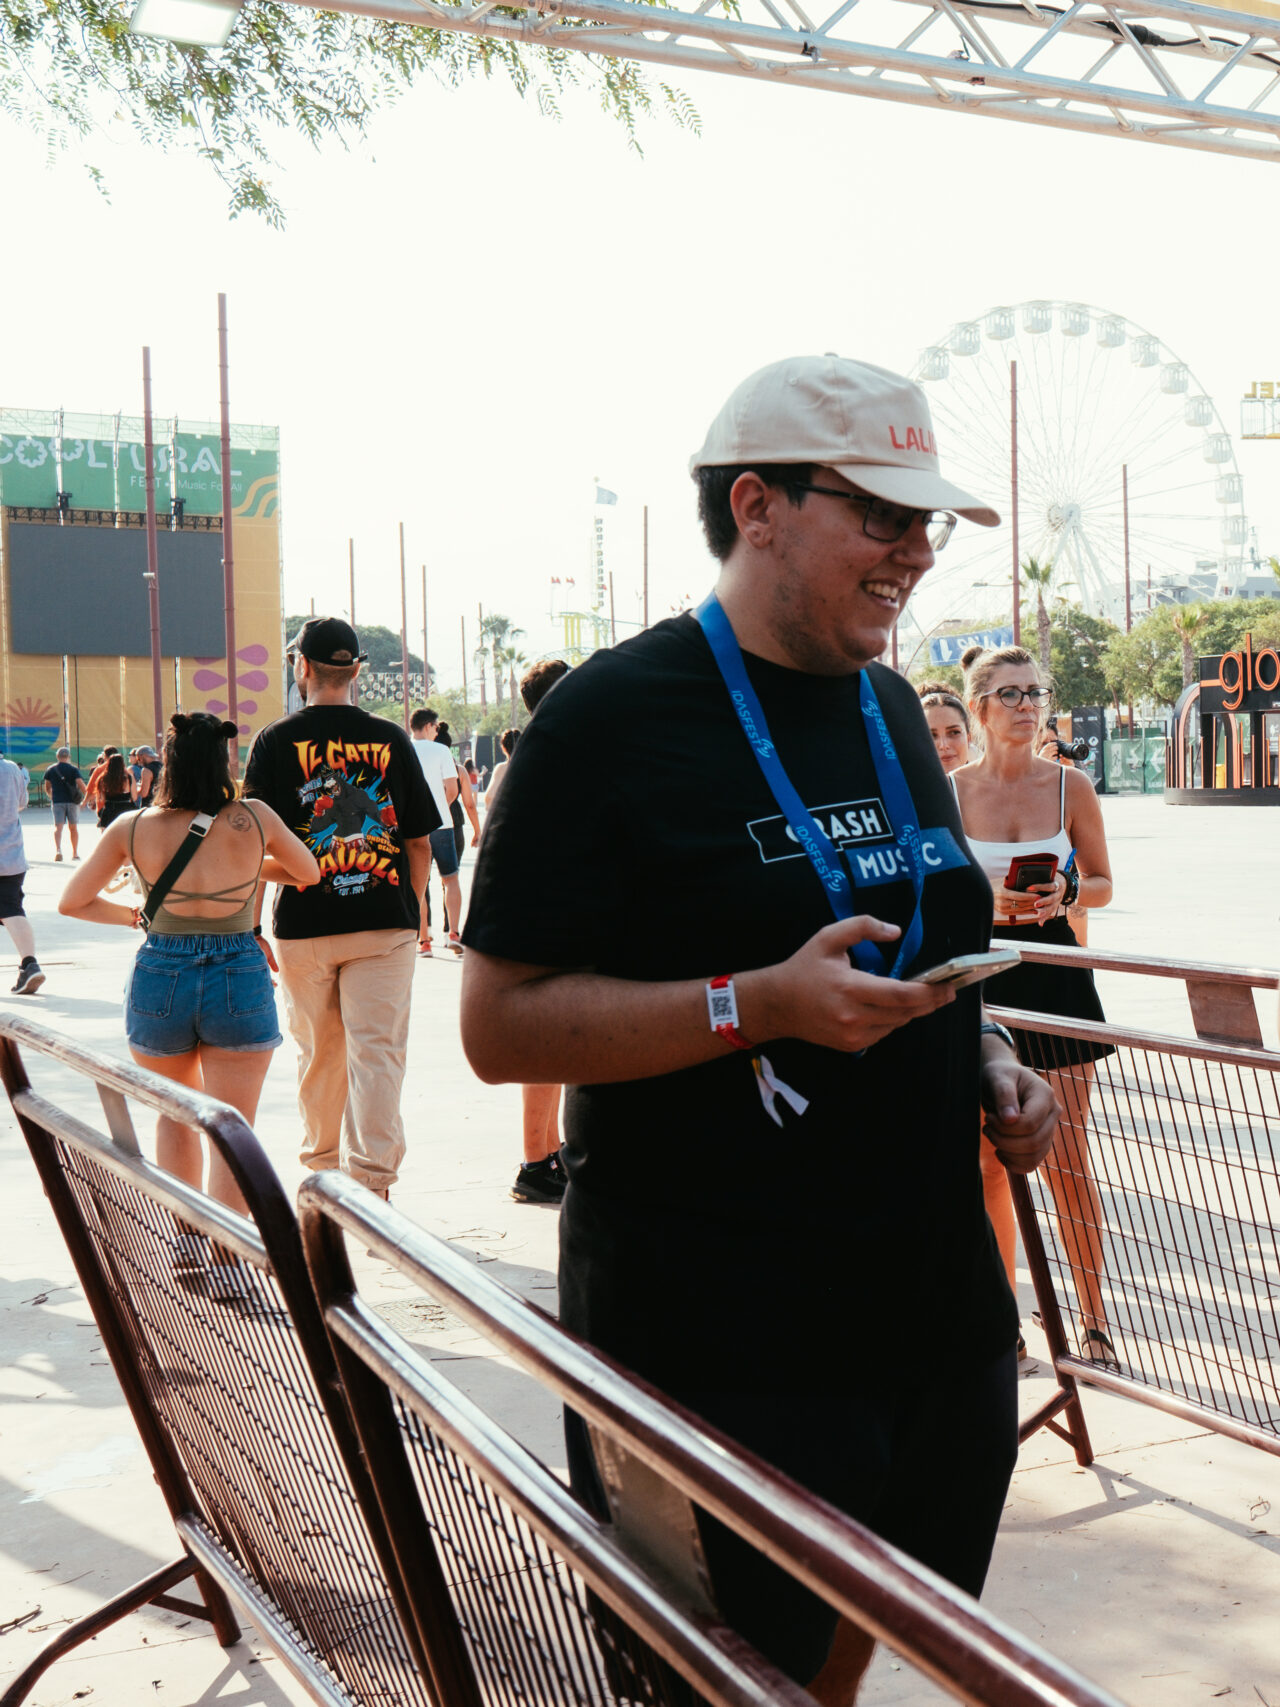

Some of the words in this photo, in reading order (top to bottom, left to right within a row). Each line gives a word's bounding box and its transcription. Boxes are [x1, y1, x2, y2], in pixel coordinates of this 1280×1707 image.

[130, 475, 161, 488] FET
[178, 479, 207, 491] Music
[1219, 632, 1280, 710] glo
[731, 690, 762, 745] IDASFEST
[873, 710, 896, 760] IDASFEST
[292, 739, 323, 782] IL
[326, 735, 392, 780] GATTO
[319, 843, 399, 886] AVOLO
[795, 825, 832, 880] IDASFEST
[856, 842, 942, 879] MUSC
